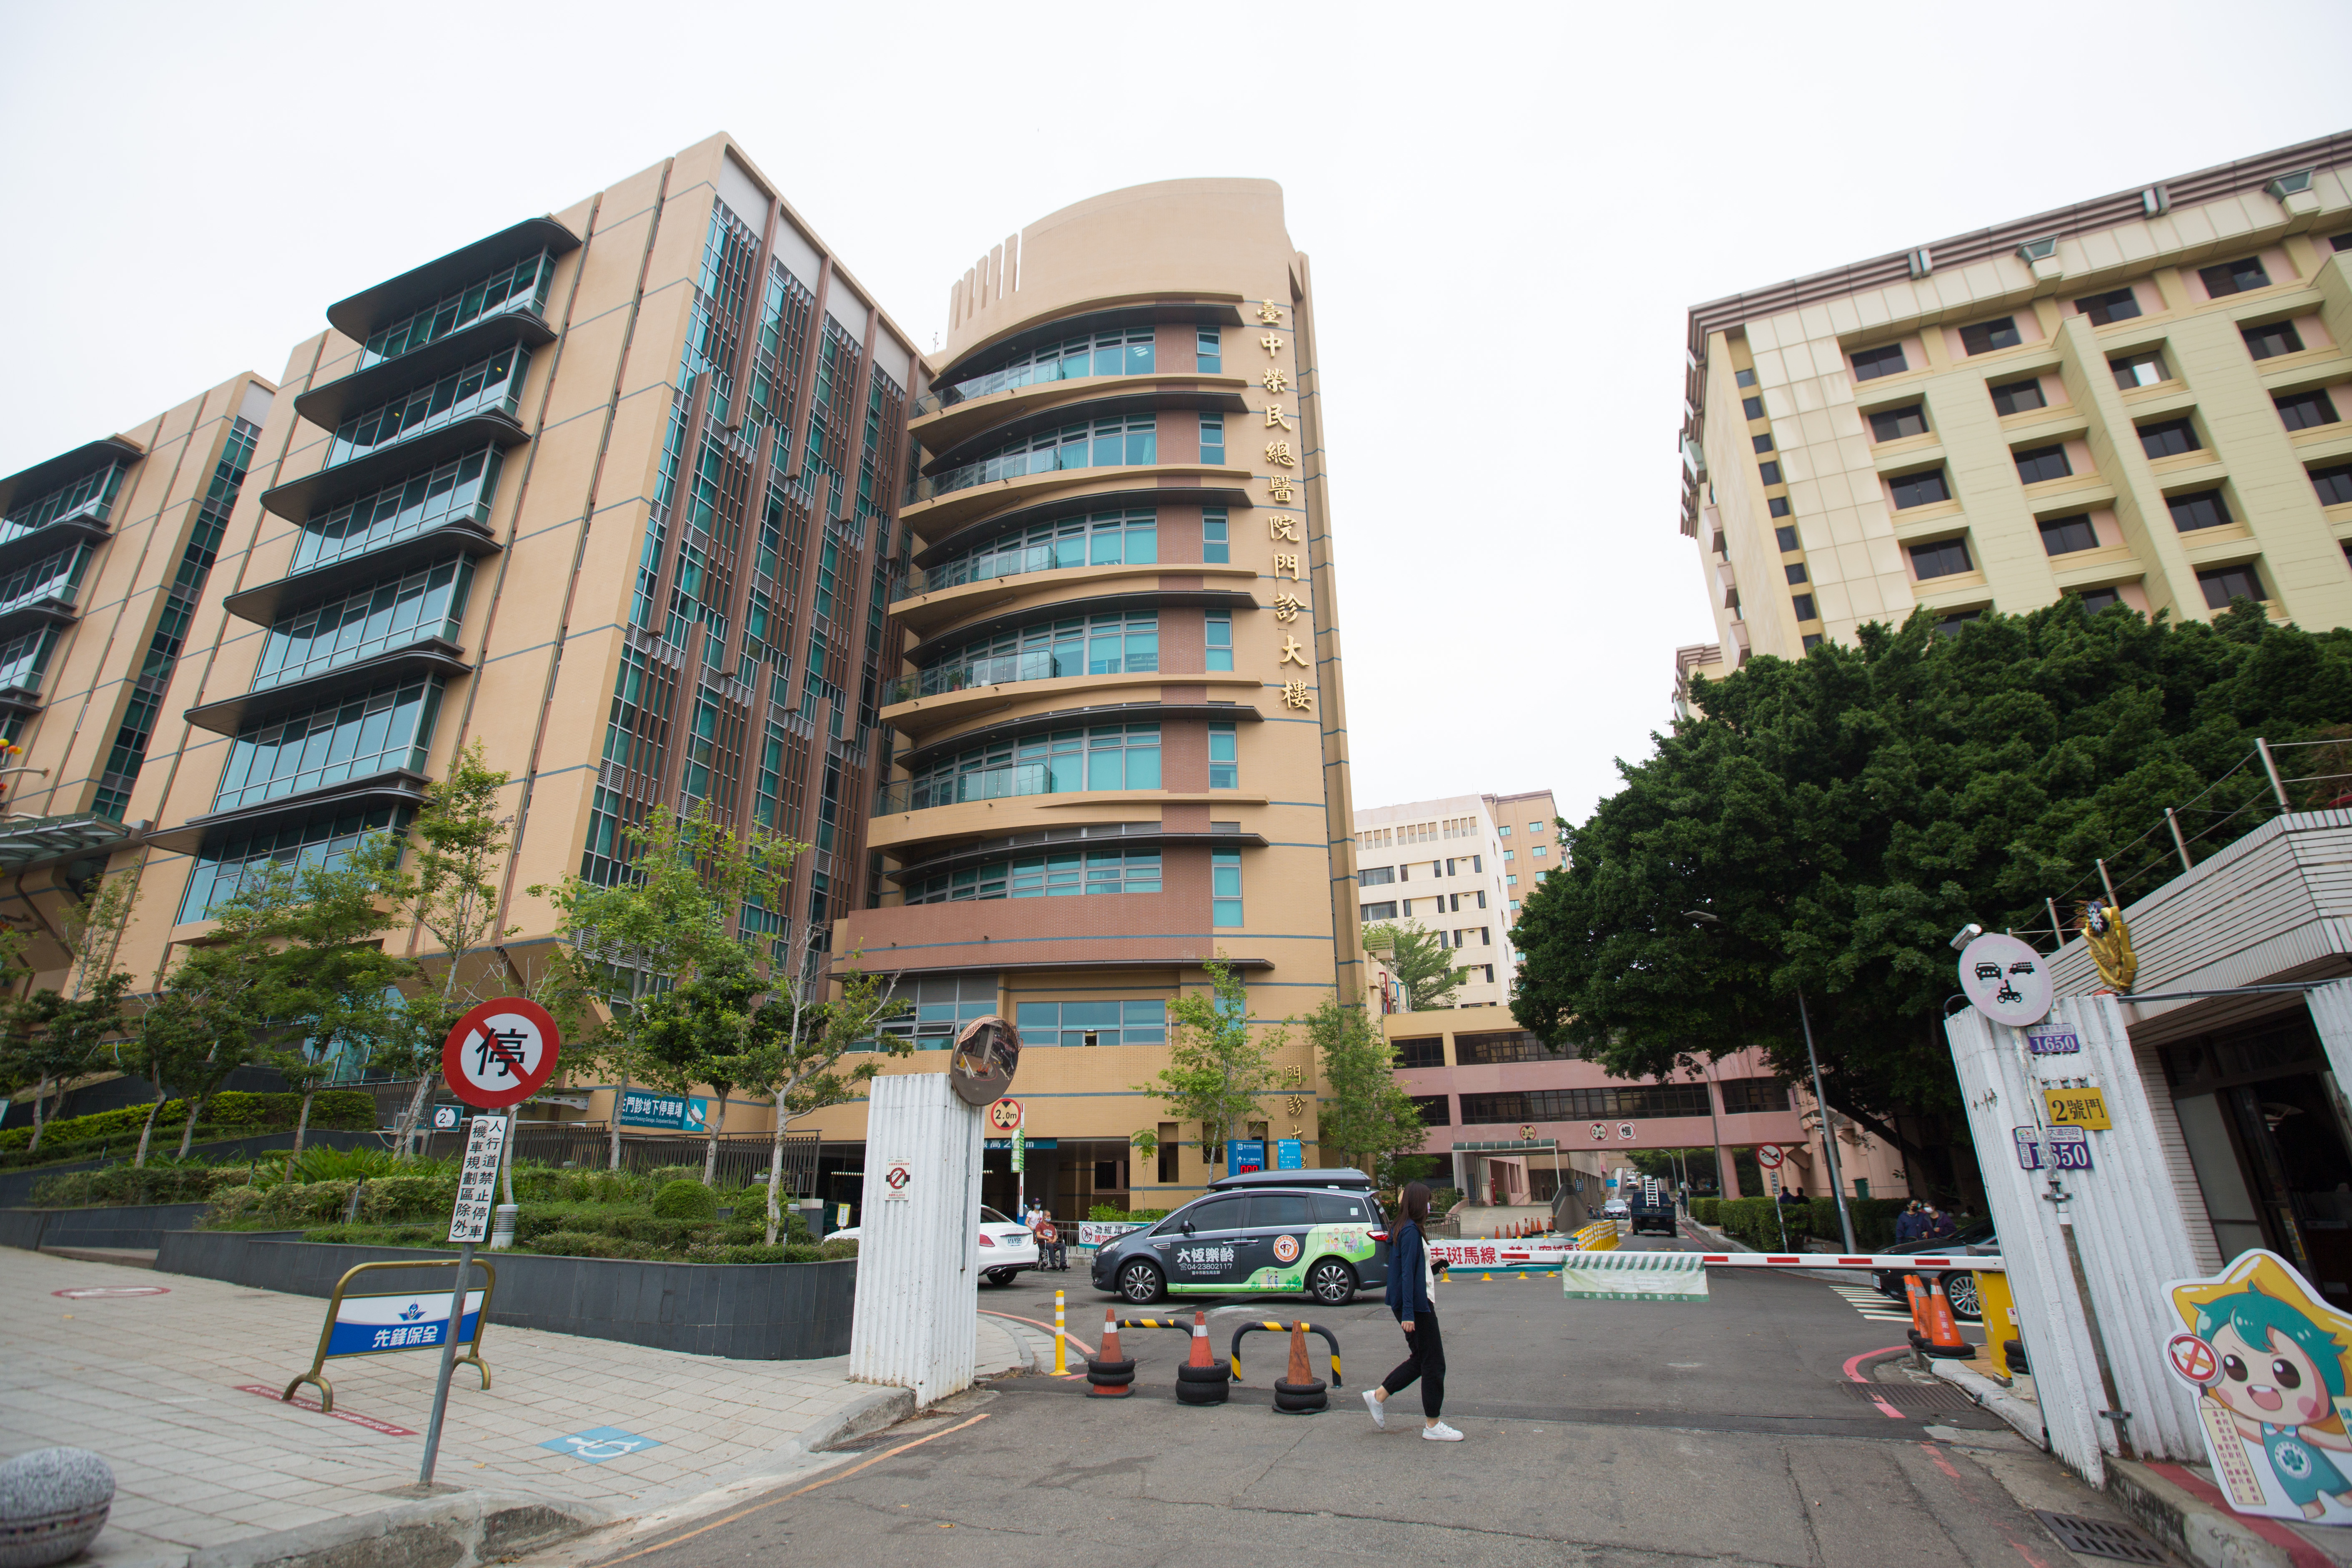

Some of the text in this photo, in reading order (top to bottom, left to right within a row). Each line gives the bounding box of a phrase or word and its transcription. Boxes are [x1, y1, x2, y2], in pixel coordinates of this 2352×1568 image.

[1256, 299, 1313, 712] 臺中榮民總醫院門診大樓
[475, 1027, 528, 1077] 停
[2034, 1036, 2075, 1051] 1650
[438, 1113, 451, 1124] 2m
[995, 1109, 1017, 1119] 2.0m
[2052, 1098, 2105, 1121] 2號門
[1621, 1126, 1632, 1136] 慢
[451, 1119, 487, 1238] (機車規劃區除外)
[468, 1120, 502, 1238] 人行道禁止停車
[1177, 1247, 1234, 1263] 大恆樂齡
[372, 1325, 439, 1348] 先鋒保全
